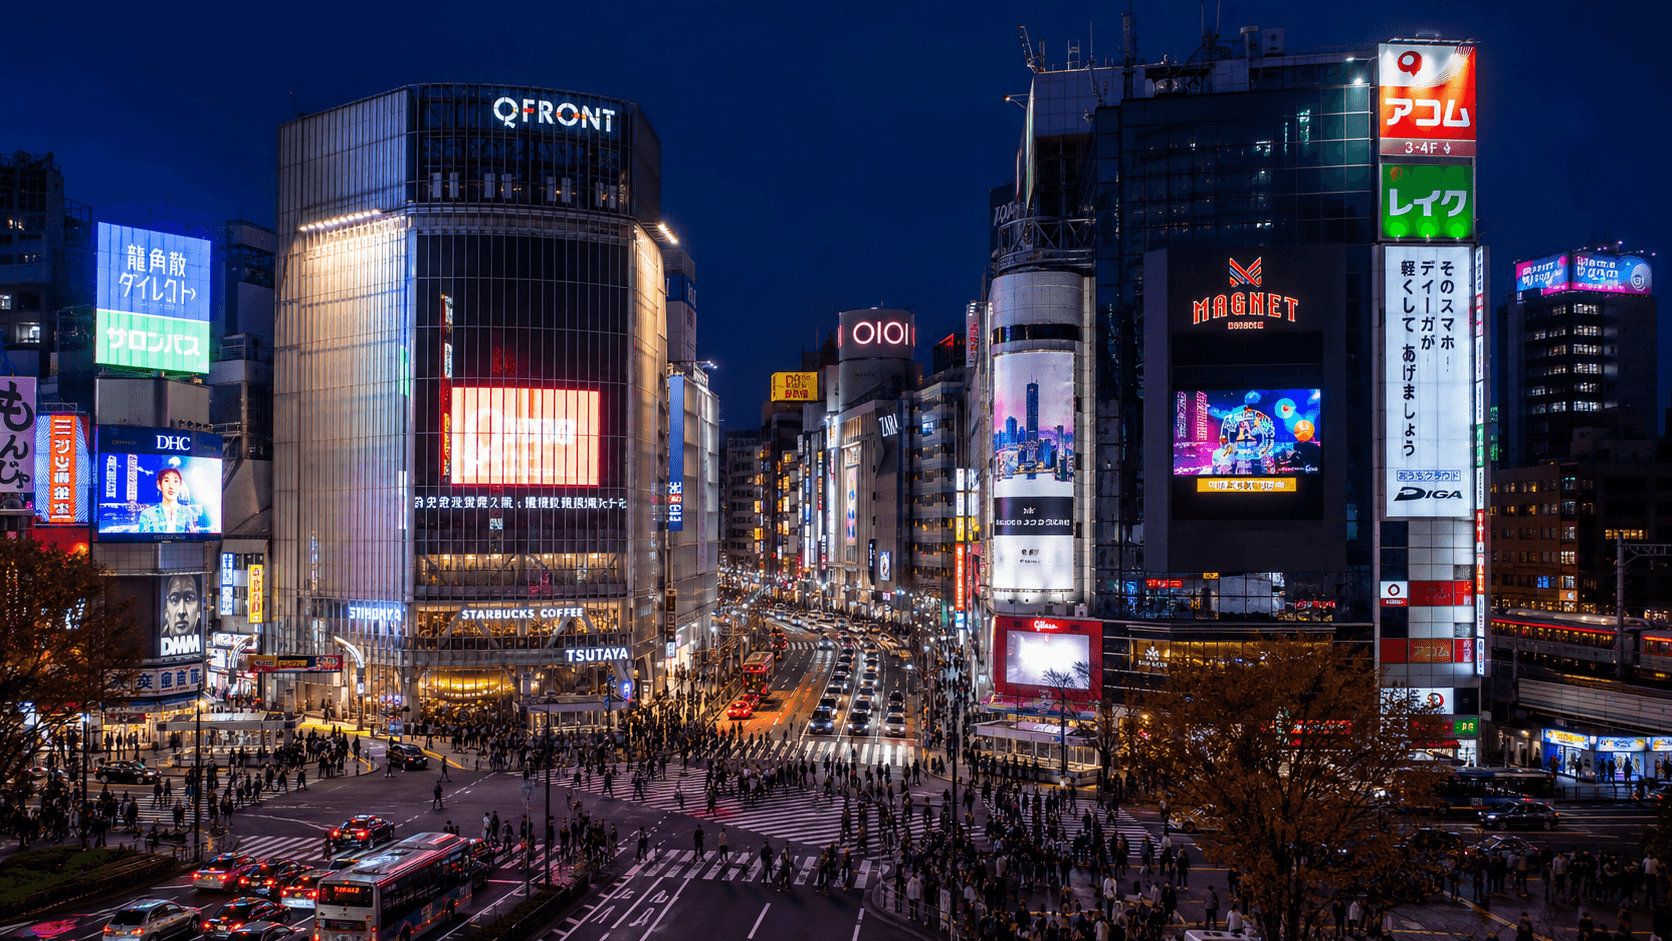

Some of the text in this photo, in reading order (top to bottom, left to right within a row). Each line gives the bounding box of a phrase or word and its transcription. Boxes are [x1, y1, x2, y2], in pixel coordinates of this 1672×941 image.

[493, 97, 615, 132] QFRONT
[1385, 98, 1471, 127] アコム
[1405, 142, 1437, 153] 3-4F
[1389, 189, 1467, 217] レイク
[127, 244, 186, 277] 龍角散
[119, 271, 193, 305] ダイレクト
[1193, 292, 1299, 325] MAGNET
[106, 327, 200, 357] サロンパス
[156, 435, 191, 451] DHC
[1393, 486, 1463, 501] DIGA
[461, 607, 583, 620] STARBUCKS COFFEE
[160, 633, 201, 657] DMM
[565, 647, 629, 662] TSUTAYA
